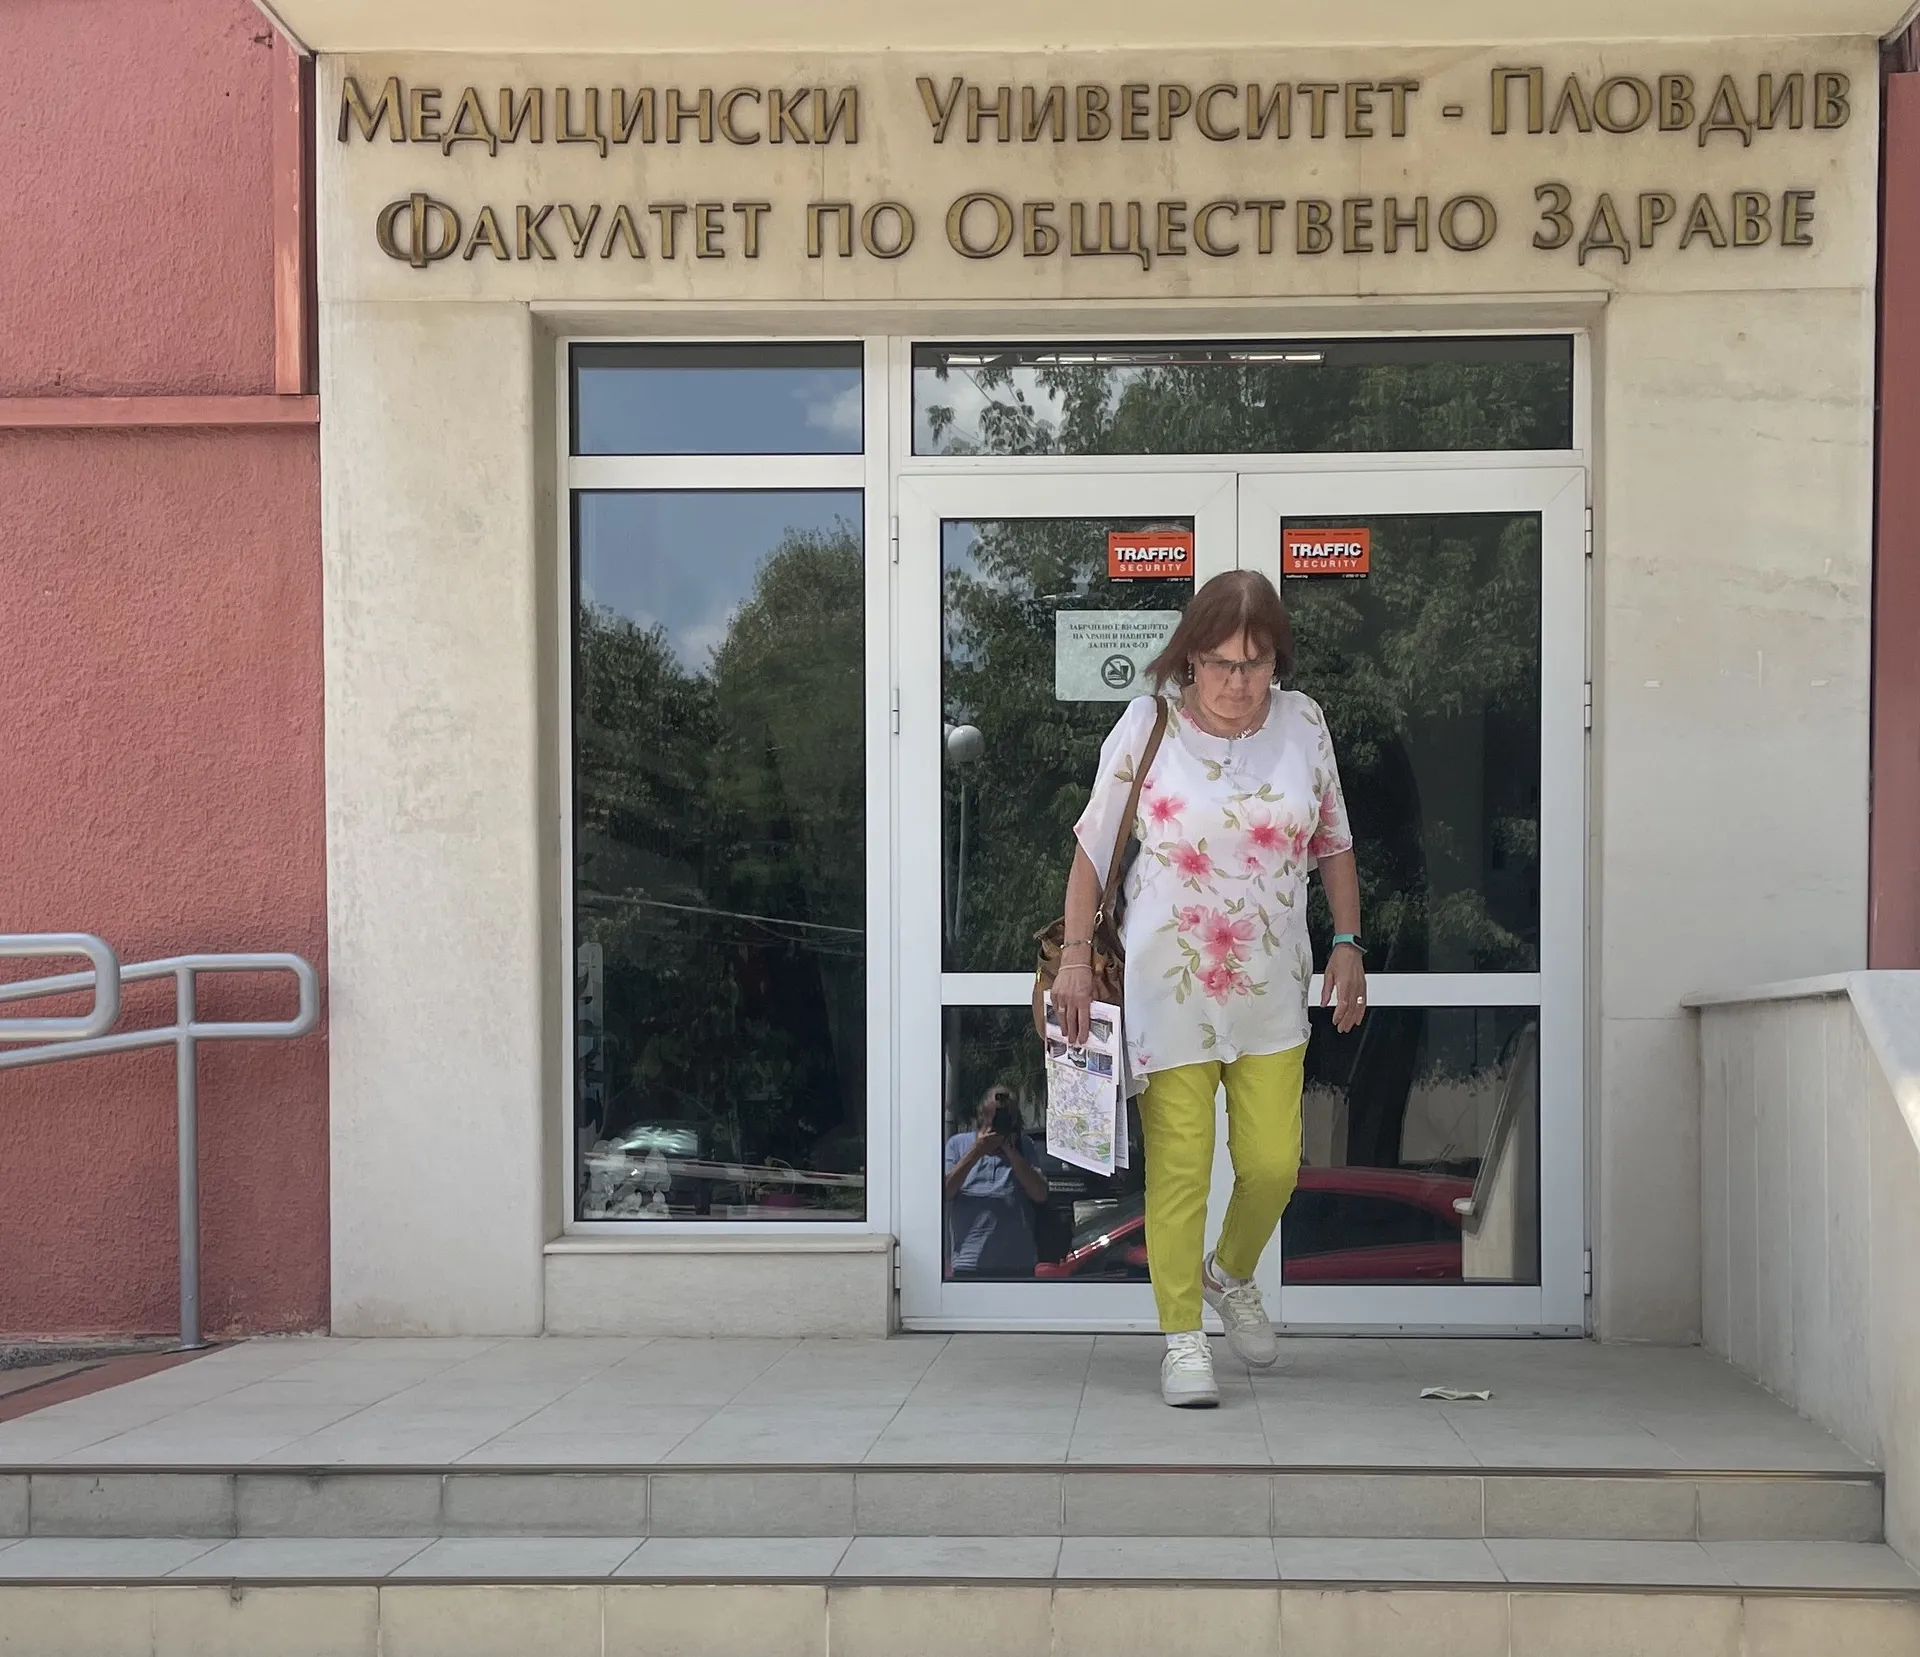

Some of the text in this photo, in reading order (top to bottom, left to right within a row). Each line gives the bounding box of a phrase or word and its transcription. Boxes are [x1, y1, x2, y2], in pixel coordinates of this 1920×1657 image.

[806, 201, 915, 259] ПО
[1114, 546, 1188, 562] TRAFFIC
[1289, 543, 1364, 559] TRAFFIC
[1120, 563, 1182, 572] SECURITY
[1294, 560, 1358, 568] SECURITY
